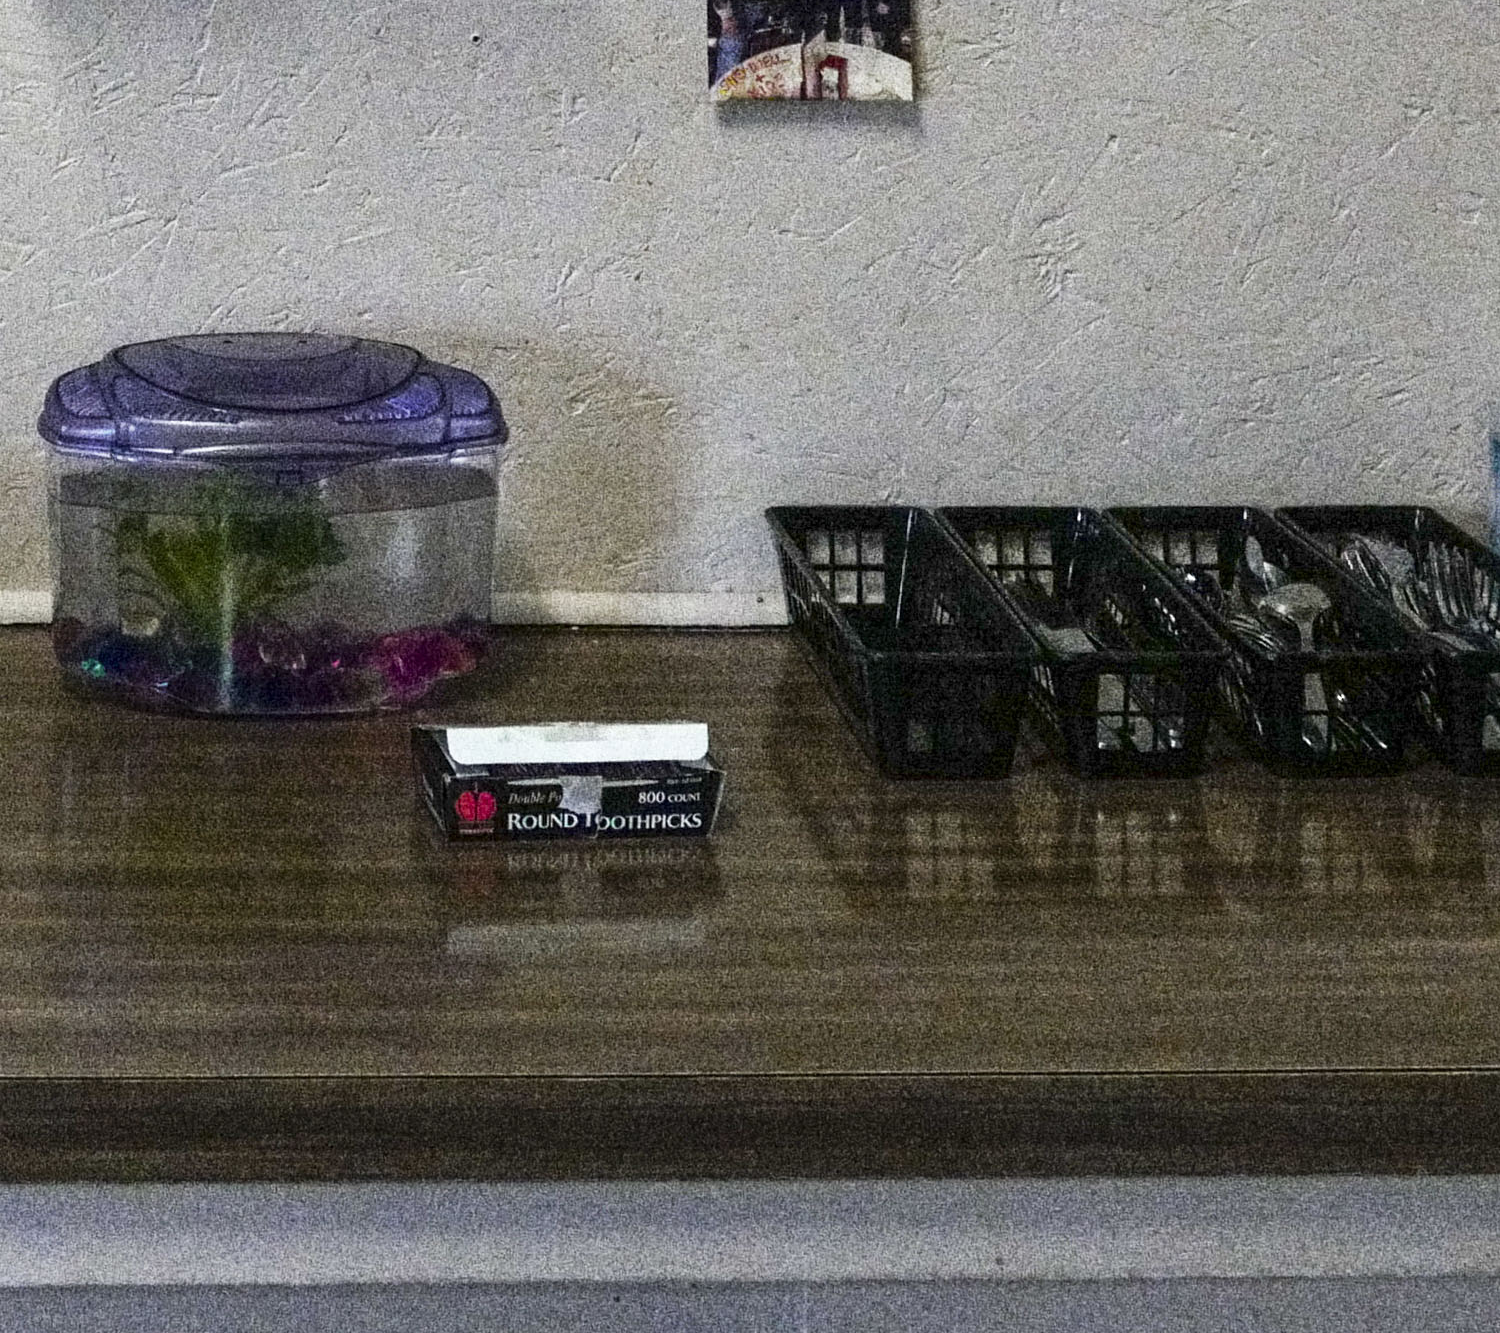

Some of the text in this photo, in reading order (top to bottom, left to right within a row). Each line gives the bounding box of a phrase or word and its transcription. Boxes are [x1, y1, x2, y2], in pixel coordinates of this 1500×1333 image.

[507, 792, 547, 805] Double
[638, 790, 667, 805] 800
[667, 792, 702, 804] COUNT
[507, 812, 579, 831] ROUND
[584, 811, 703, 832] TOOTHPICKS
